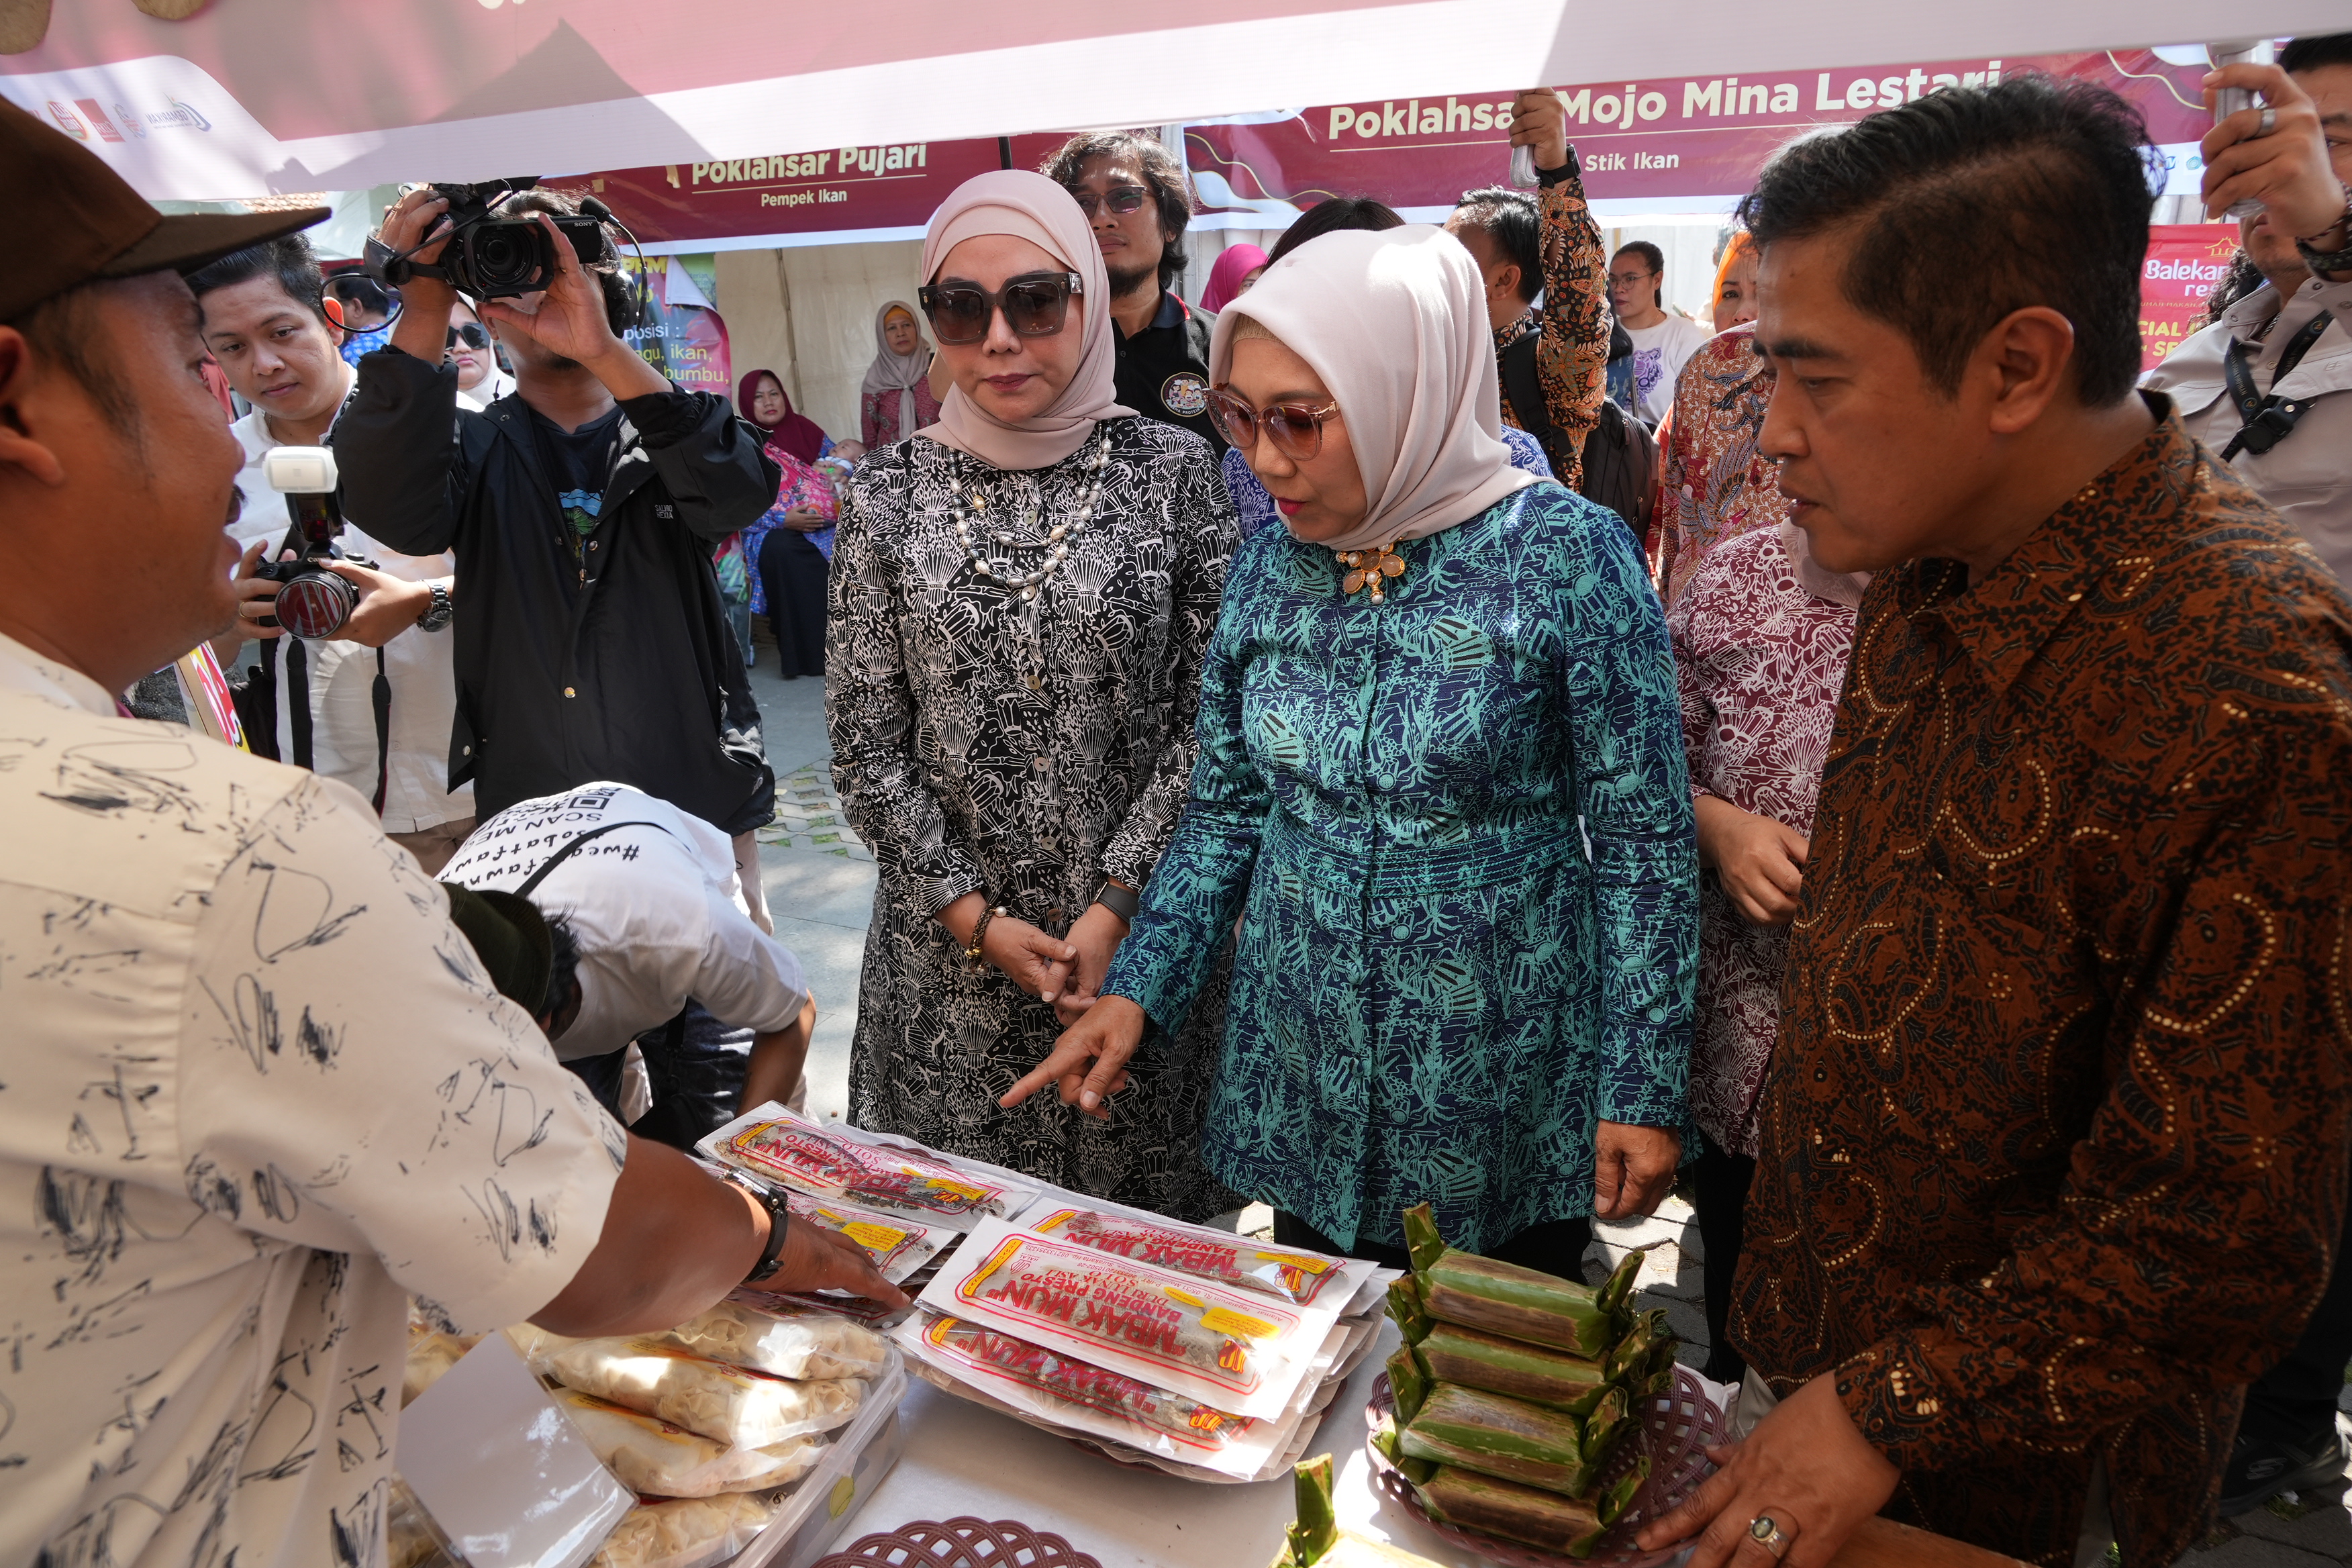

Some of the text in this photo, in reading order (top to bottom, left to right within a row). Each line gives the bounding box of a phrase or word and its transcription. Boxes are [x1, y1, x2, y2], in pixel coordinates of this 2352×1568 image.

[1328, 96, 1516, 140] Poklahsa
[1555, 84, 1667, 130] Mojo
[1682, 77, 1800, 119] Mina
[838, 141, 928, 177] Pujari
[1585, 151, 1679, 173] Stik Ikan
[761, 188, 848, 208] Pempek Ikan
[624, 322, 669, 343] posisi
[2137, 320, 2182, 337] CIAL
[635, 343, 713, 365] agu, ikan,
[663, 365, 730, 384] bumbu,
[524, 812, 603, 831] SCAN
[785, 1134, 841, 1165] PRESTO
[841, 1142, 882, 1166] SOLO
[1150, 1238, 1238, 1257] BANDENG
[1020, 1254, 1040, 1263] HALAL
[1082, 1255, 1115, 1268] Surakarta
[1045, 1269, 1169, 1307] DURI LUNAK ASLI
[1088, 1271, 1139, 1288] SOLO
[1021, 1273, 1183, 1322] BANDENG PRESTO
[1182, 1285, 1202, 1297] 05/31
[1257, 1310, 1284, 1322] Alamat
